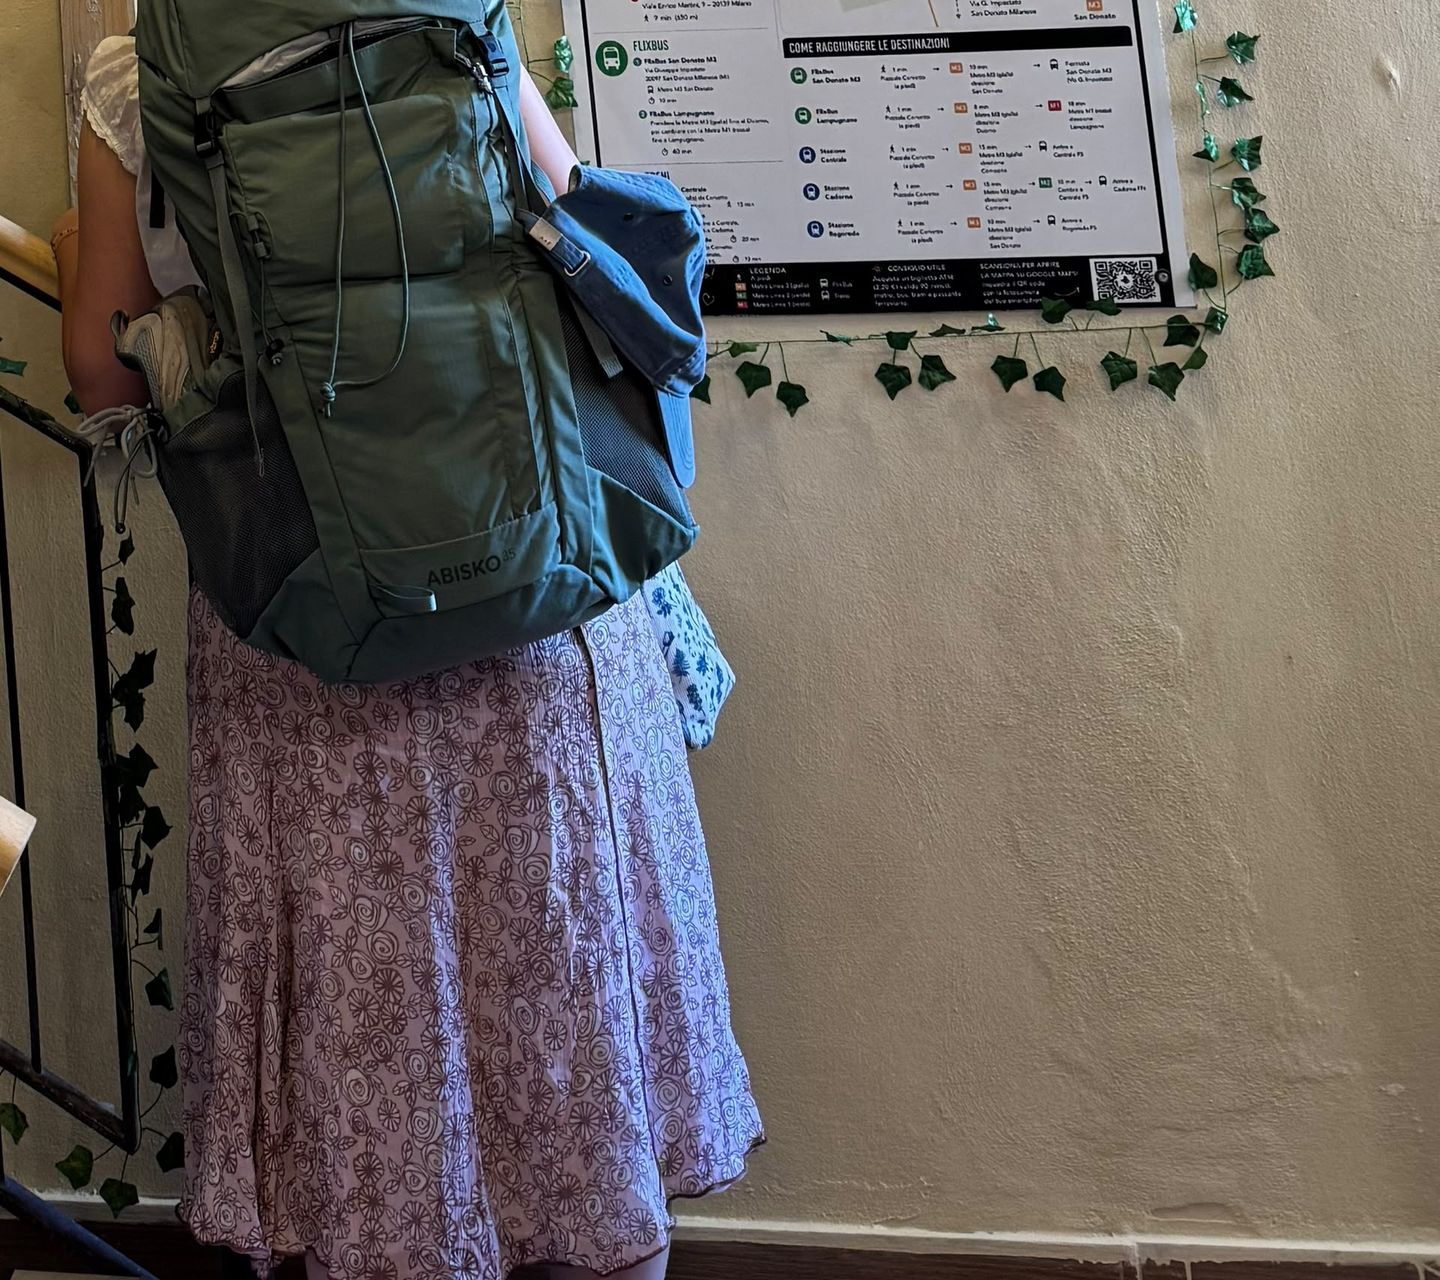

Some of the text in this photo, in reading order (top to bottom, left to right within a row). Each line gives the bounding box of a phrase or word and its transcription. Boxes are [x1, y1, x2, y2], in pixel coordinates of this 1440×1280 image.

[632, 39, 669, 51] FLIXBUS
[788, 37, 950, 53] COME RAGGIUNGERE LE DESTINAZIONI
[427, 554, 502, 588] ABISKO
